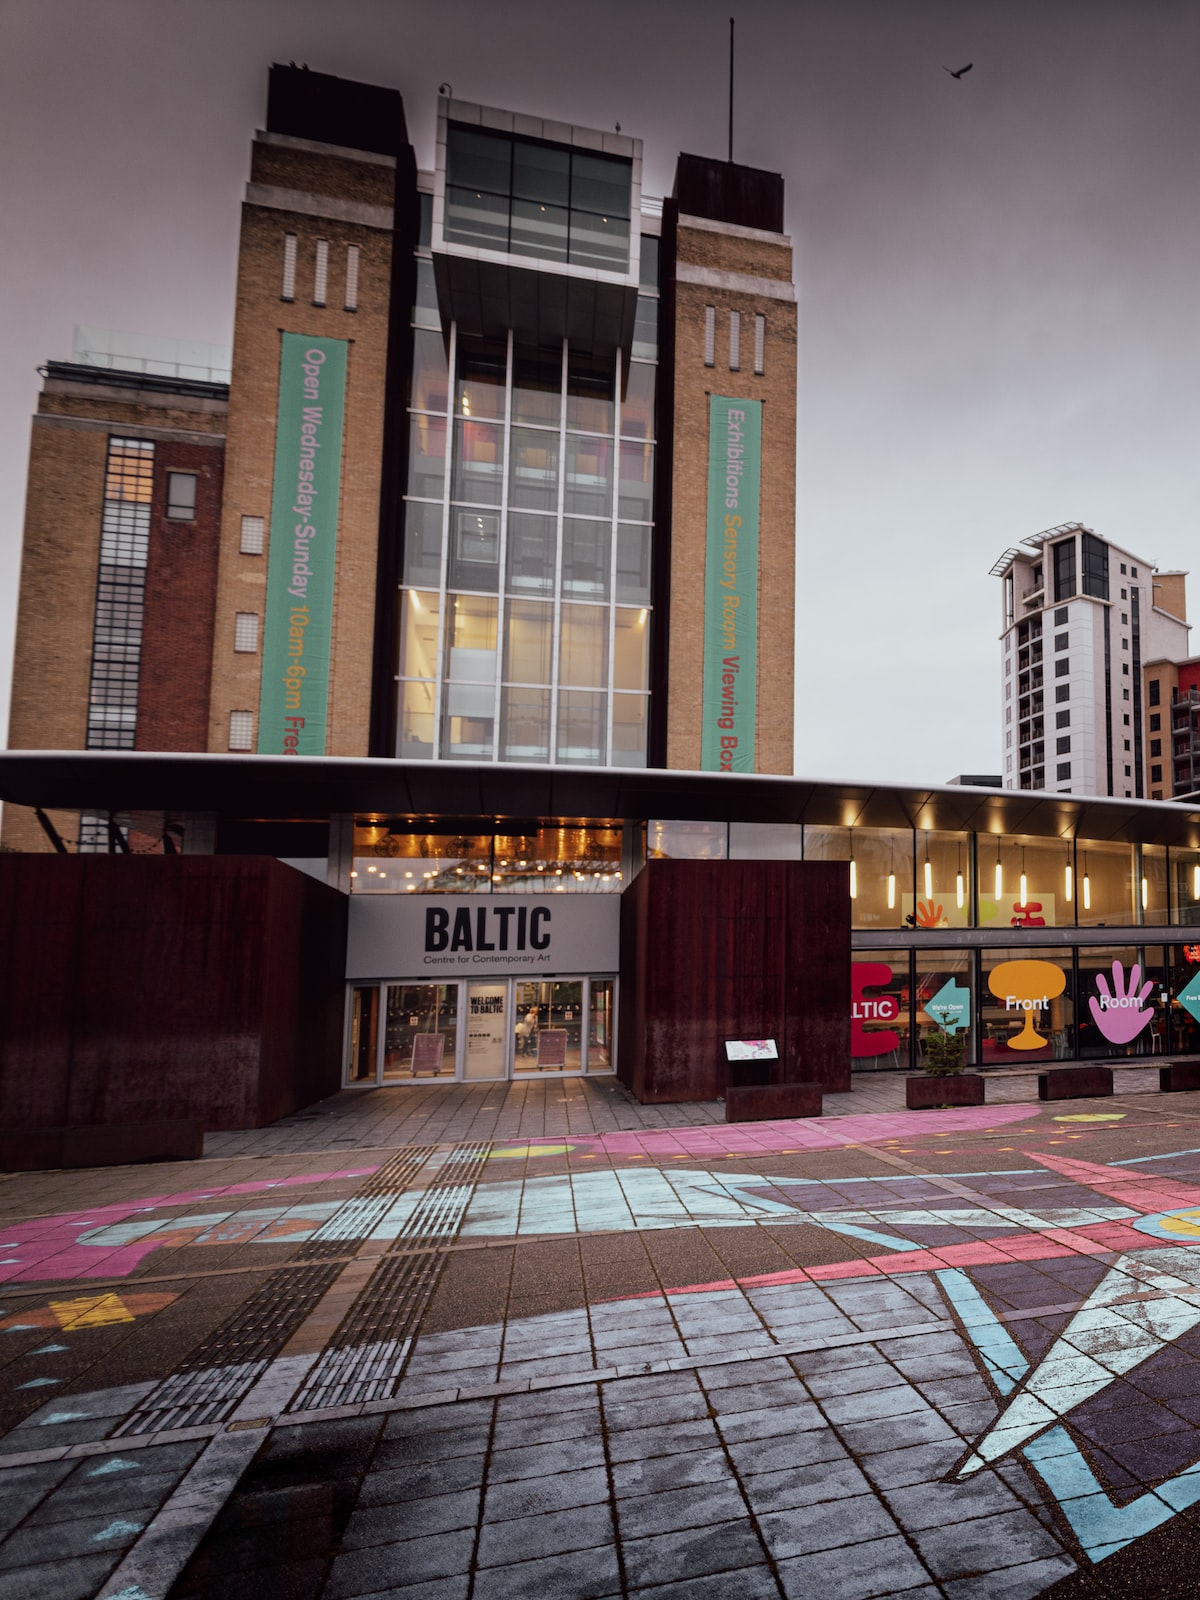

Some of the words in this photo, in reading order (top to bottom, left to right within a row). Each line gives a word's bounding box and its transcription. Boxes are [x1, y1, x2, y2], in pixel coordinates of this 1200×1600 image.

[301, 348, 326, 400] Open
[725, 408, 745, 509] Exhibitions
[288, 406, 323, 599] Wednesday-Sunday
[720, 514, 743, 590] Sensory
[722, 595, 741, 650] Room
[282, 605, 310, 709] 10am-6pm
[717, 655, 740, 729] Viewing
[719, 736, 739, 772] Box
[425, 906, 552, 952] BALTIC
[423, 955, 455, 964] Centre
[458, 954, 470, 964] for
[472, 954, 535, 964] Contemporary
[538, 953, 551, 962] Art
[470, 996, 504, 1005] WELCOME
[470, 1006, 479, 1014] TO
[480, 1005, 504, 1014] BALTIC
[948, 1003, 964, 1011] Open
[1005, 995, 1050, 1011] Front
[1100, 994, 1143, 1009] Room
